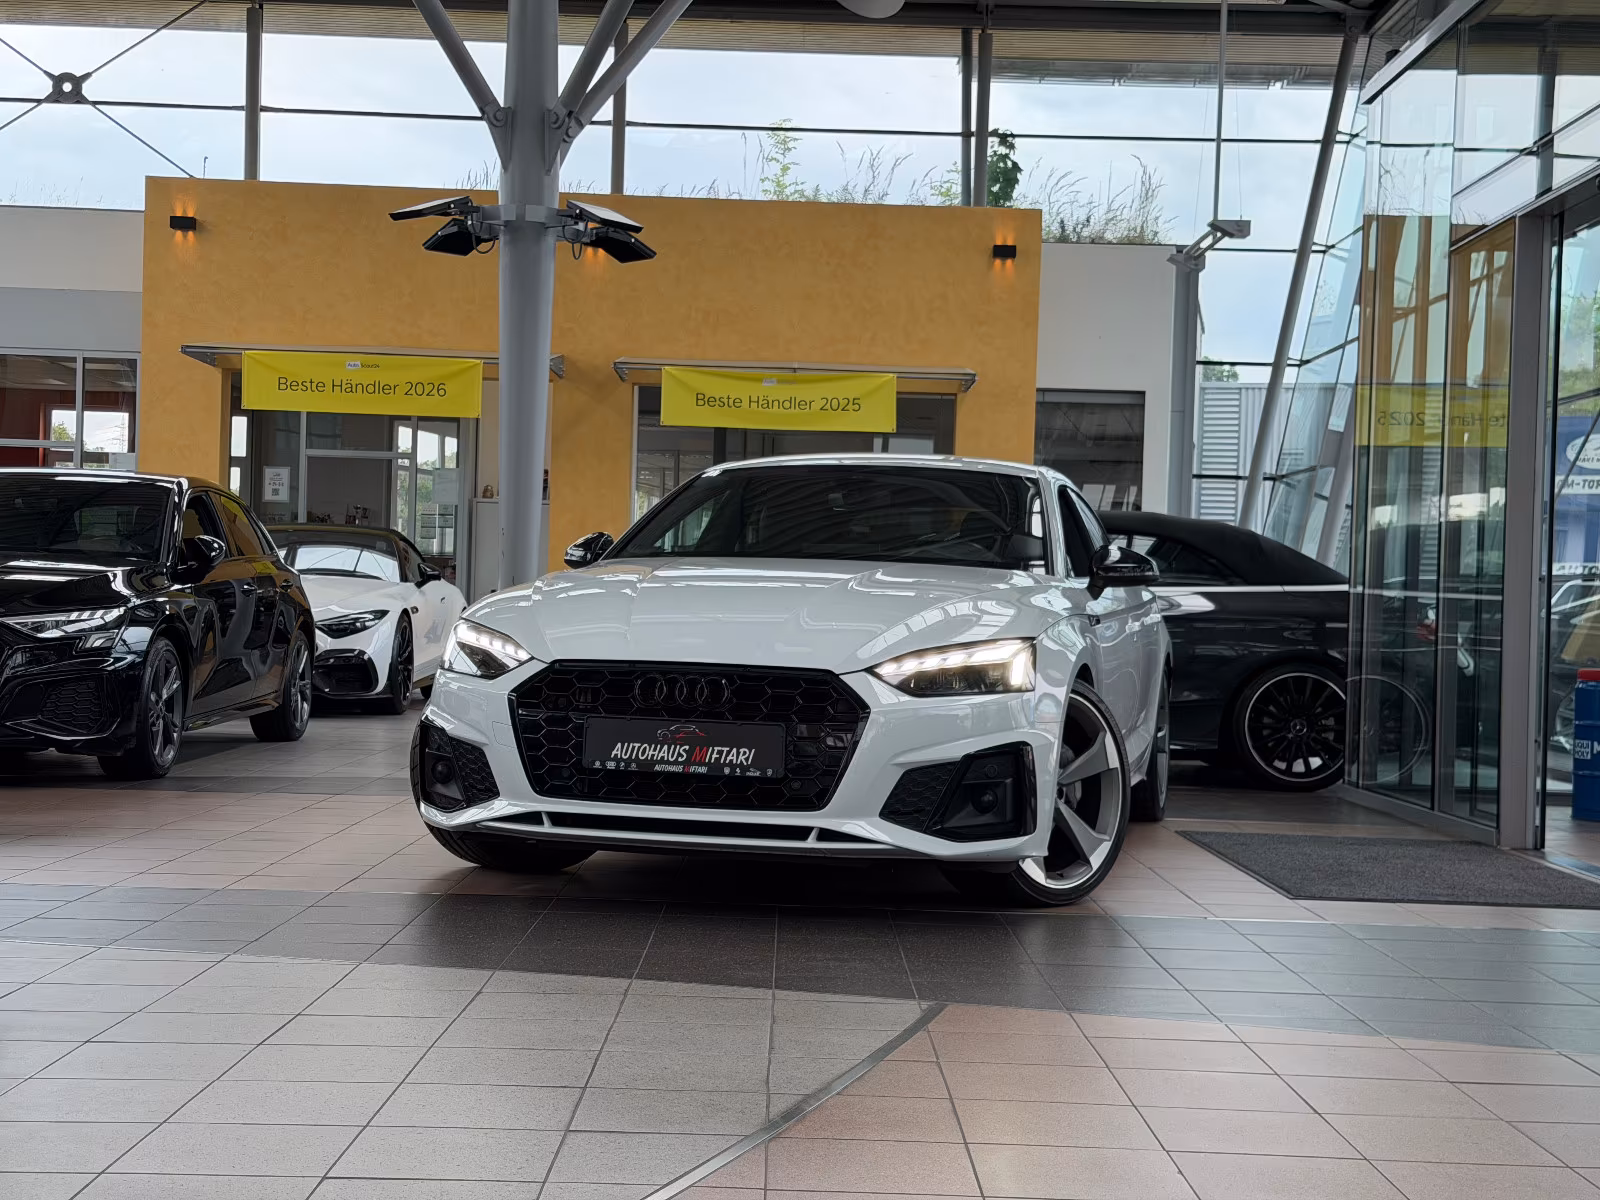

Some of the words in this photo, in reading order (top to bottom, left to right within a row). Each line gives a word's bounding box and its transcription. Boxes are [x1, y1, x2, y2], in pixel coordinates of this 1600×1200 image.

[277, 376, 326, 393] Beste
[331, 378, 400, 396] Händler
[403, 381, 447, 398] 2026
[695, 392, 743, 409] Beste
[748, 394, 815, 411] Händler
[819, 397, 862, 412] 2025
[611, 742, 690, 762] AUTOHAUS
[691, 746, 756, 766] MIFTARI
[653, 764, 684, 773] AUTOHAUS
[684, 765, 708, 774] MIFTARI
